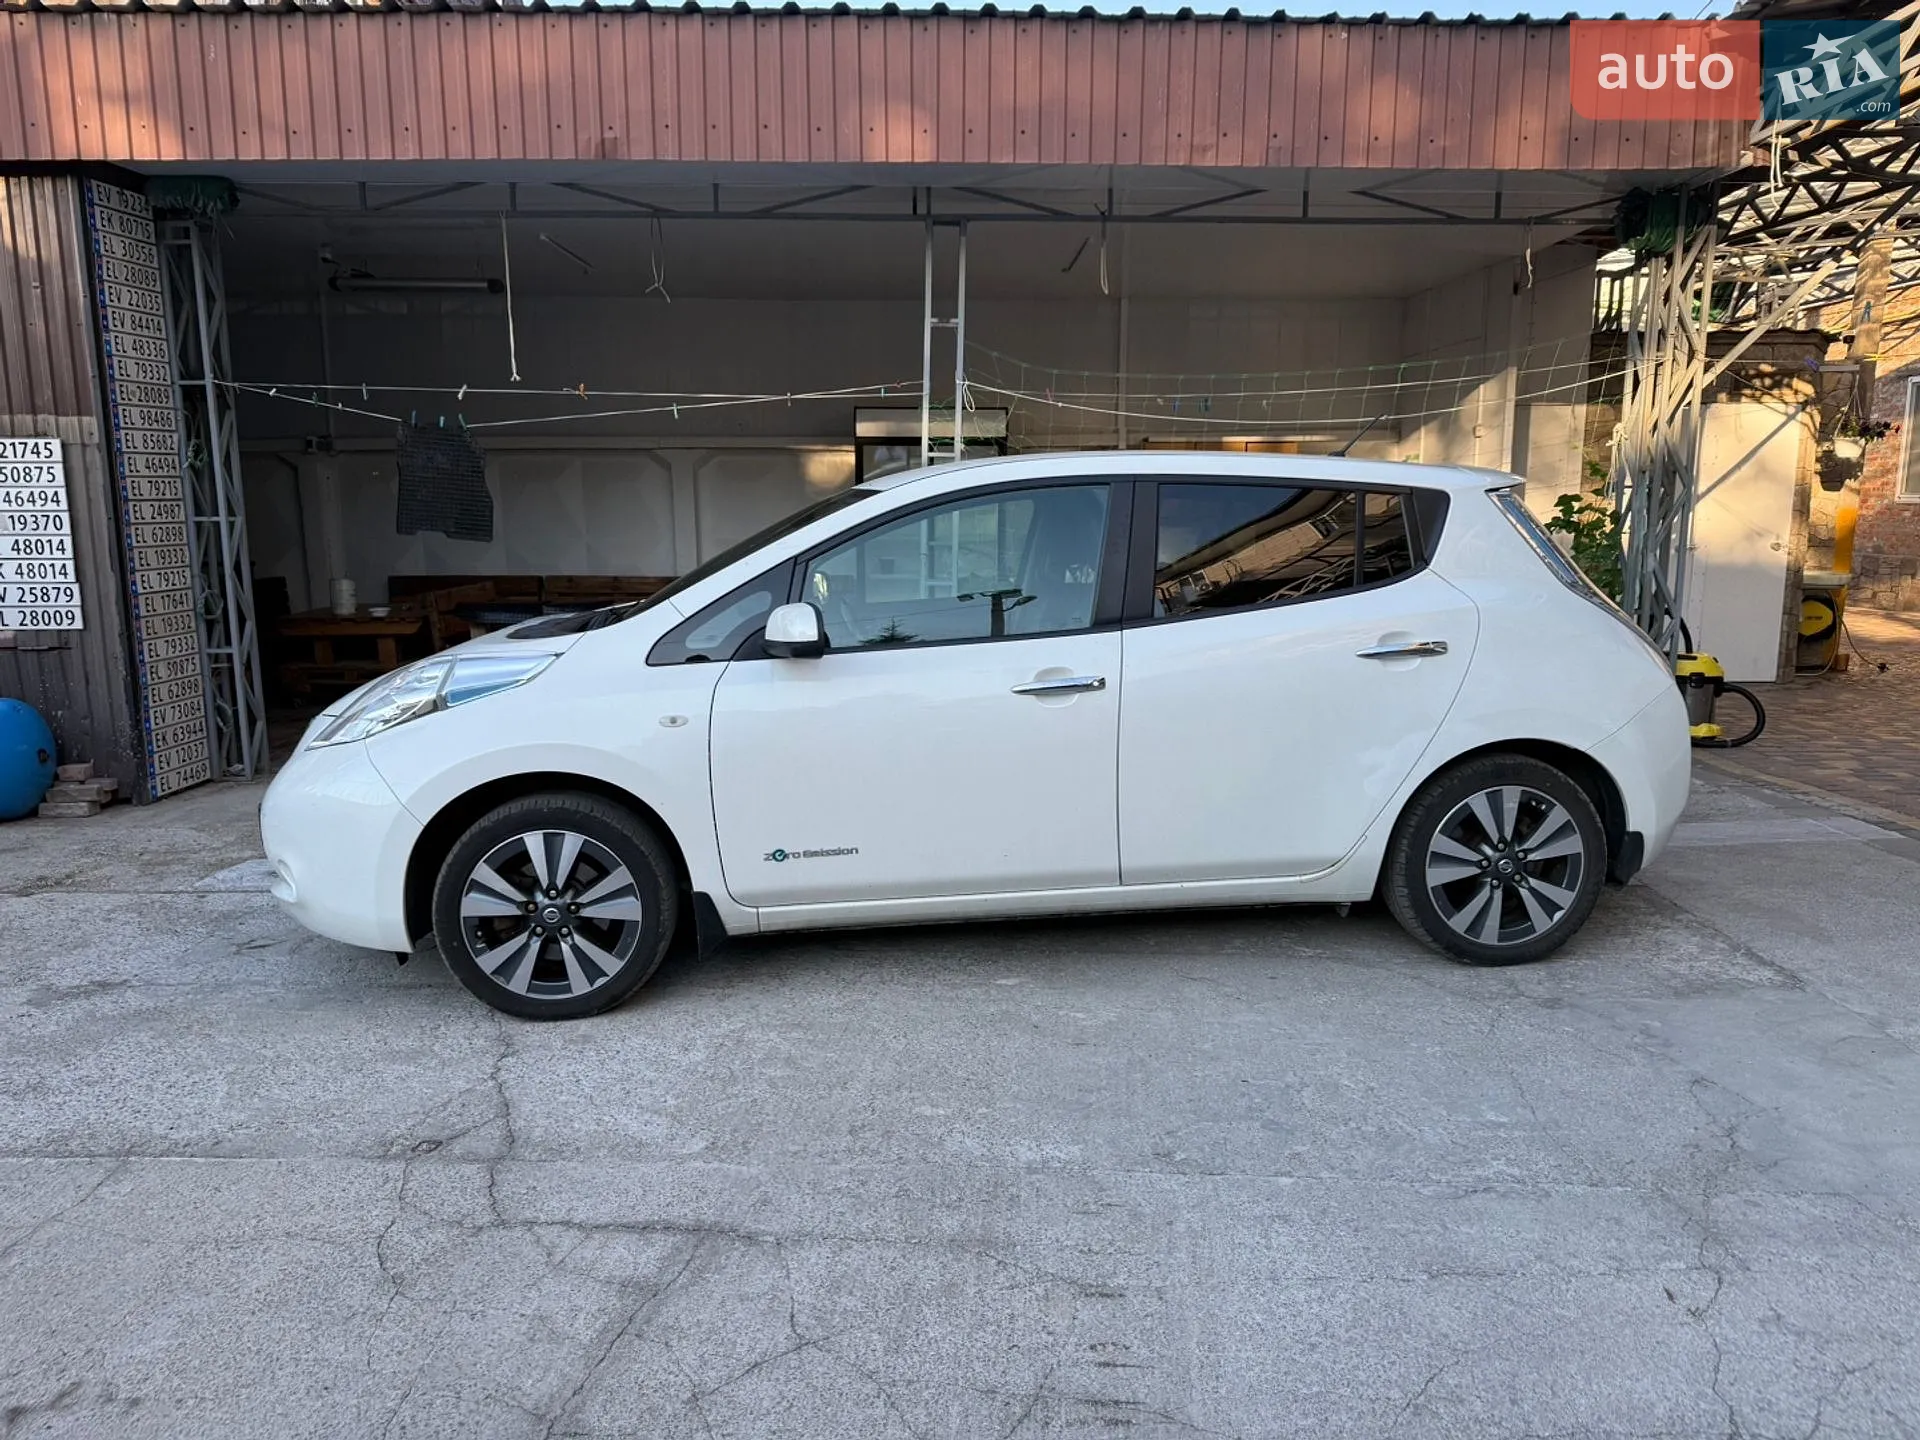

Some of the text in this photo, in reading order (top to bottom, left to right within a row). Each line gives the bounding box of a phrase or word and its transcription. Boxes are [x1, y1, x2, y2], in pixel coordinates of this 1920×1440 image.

[97, 183, 111, 204] EV
[101, 211, 151, 240] EK 80715
[103, 235, 155, 264] EL 30556
[106, 260, 157, 288] EL 28089
[108, 286, 161, 312] EV 22035
[112, 311, 163, 335] EV 84414
[114, 335, 167, 359] EL 48336
[118, 360, 168, 382] EL 79332
[119, 384, 170, 404] EL 28089
[122, 408, 173, 428] EL 98486
[0, 442, 53, 459] 21745
[124, 432, 175, 450] EL 85682
[0, 466, 56, 483] 50875
[127, 456, 177, 473] EL 46494
[3, 490, 61, 507] 46494
[131, 480, 178, 497] EL 79215
[133, 503, 181, 520] EL 24987
[8, 514, 63, 531] 19370
[134, 526, 184, 544] EL 62898
[11, 538, 66, 556] 48014
[138, 548, 187, 567] EL 19332
[15, 562, 69, 580] 48014
[141, 570, 188, 590] EL 79215
[16, 586, 74, 604] 25879
[145, 592, 190, 613] EL 17641
[18, 609, 76, 627] 28009
[145, 614, 193, 636] EL 19332
[147, 635, 196, 659] EL 79332
[150, 664, 163, 681] EL
[151, 678, 200, 703] EL 62898
[154, 700, 202, 726] EV 73084
[155, 720, 205, 748] EK 63944
[158, 741, 206, 770] EV 12037
[160, 763, 208, 793] EL 74469
